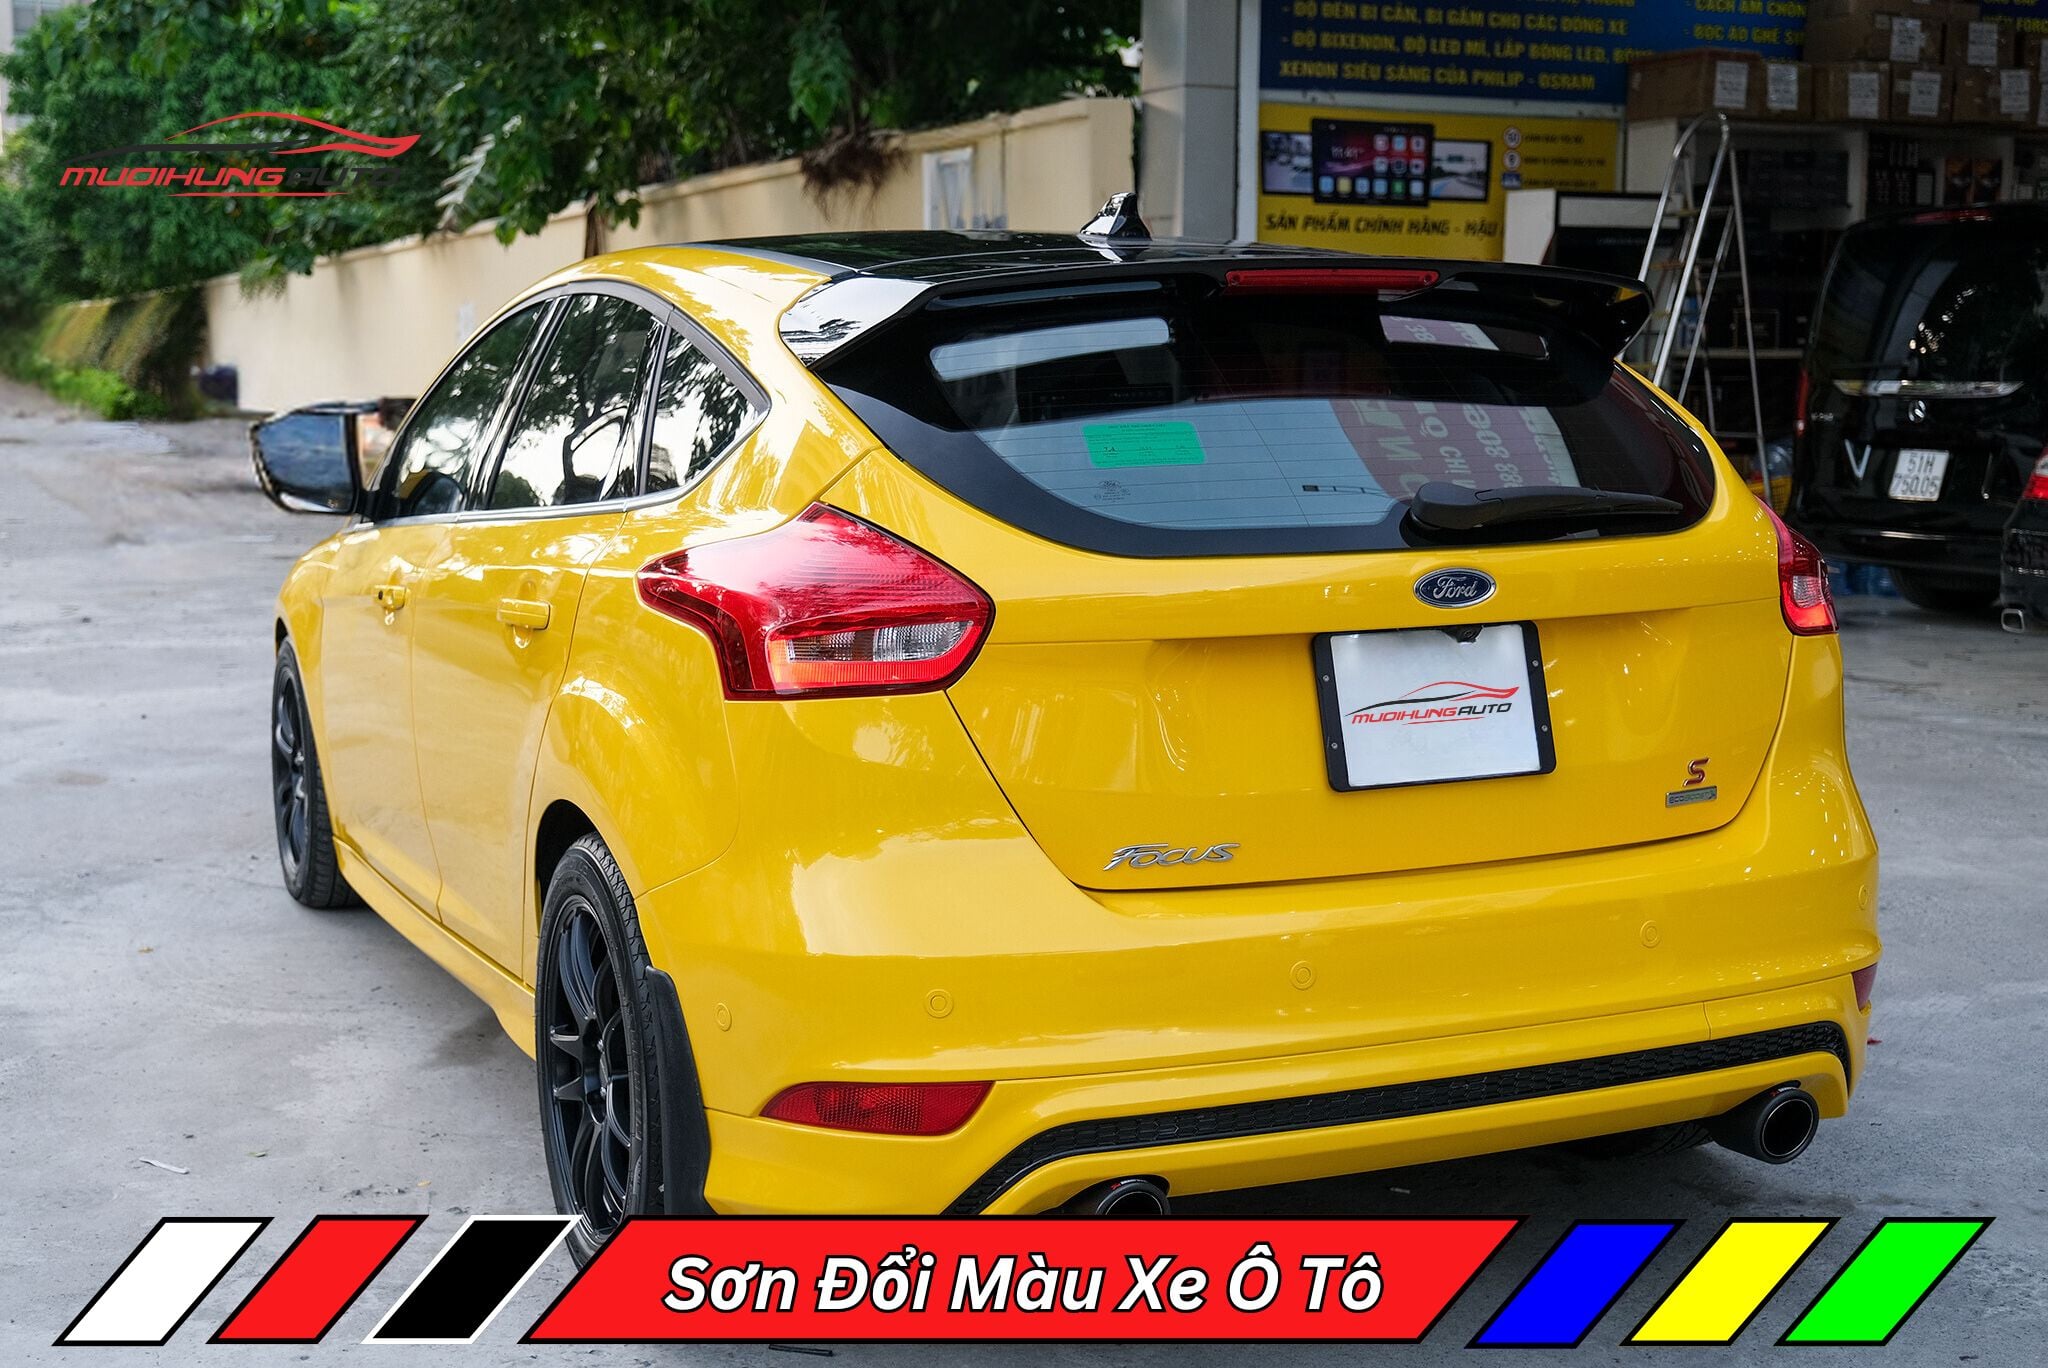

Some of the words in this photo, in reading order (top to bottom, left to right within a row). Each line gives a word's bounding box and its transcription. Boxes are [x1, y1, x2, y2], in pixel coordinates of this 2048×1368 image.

[1607, 18, 1630, 36] XE
[1279, 60, 1338, 78] XENON
[1471, 69, 1525, 88] PHILIP
[1537, 71, 1596, 91] OSRAM
[1844, 437, 1872, 481] V
[1433, 575, 1478, 599] Ford
[1683, 757, 1711, 788] S
